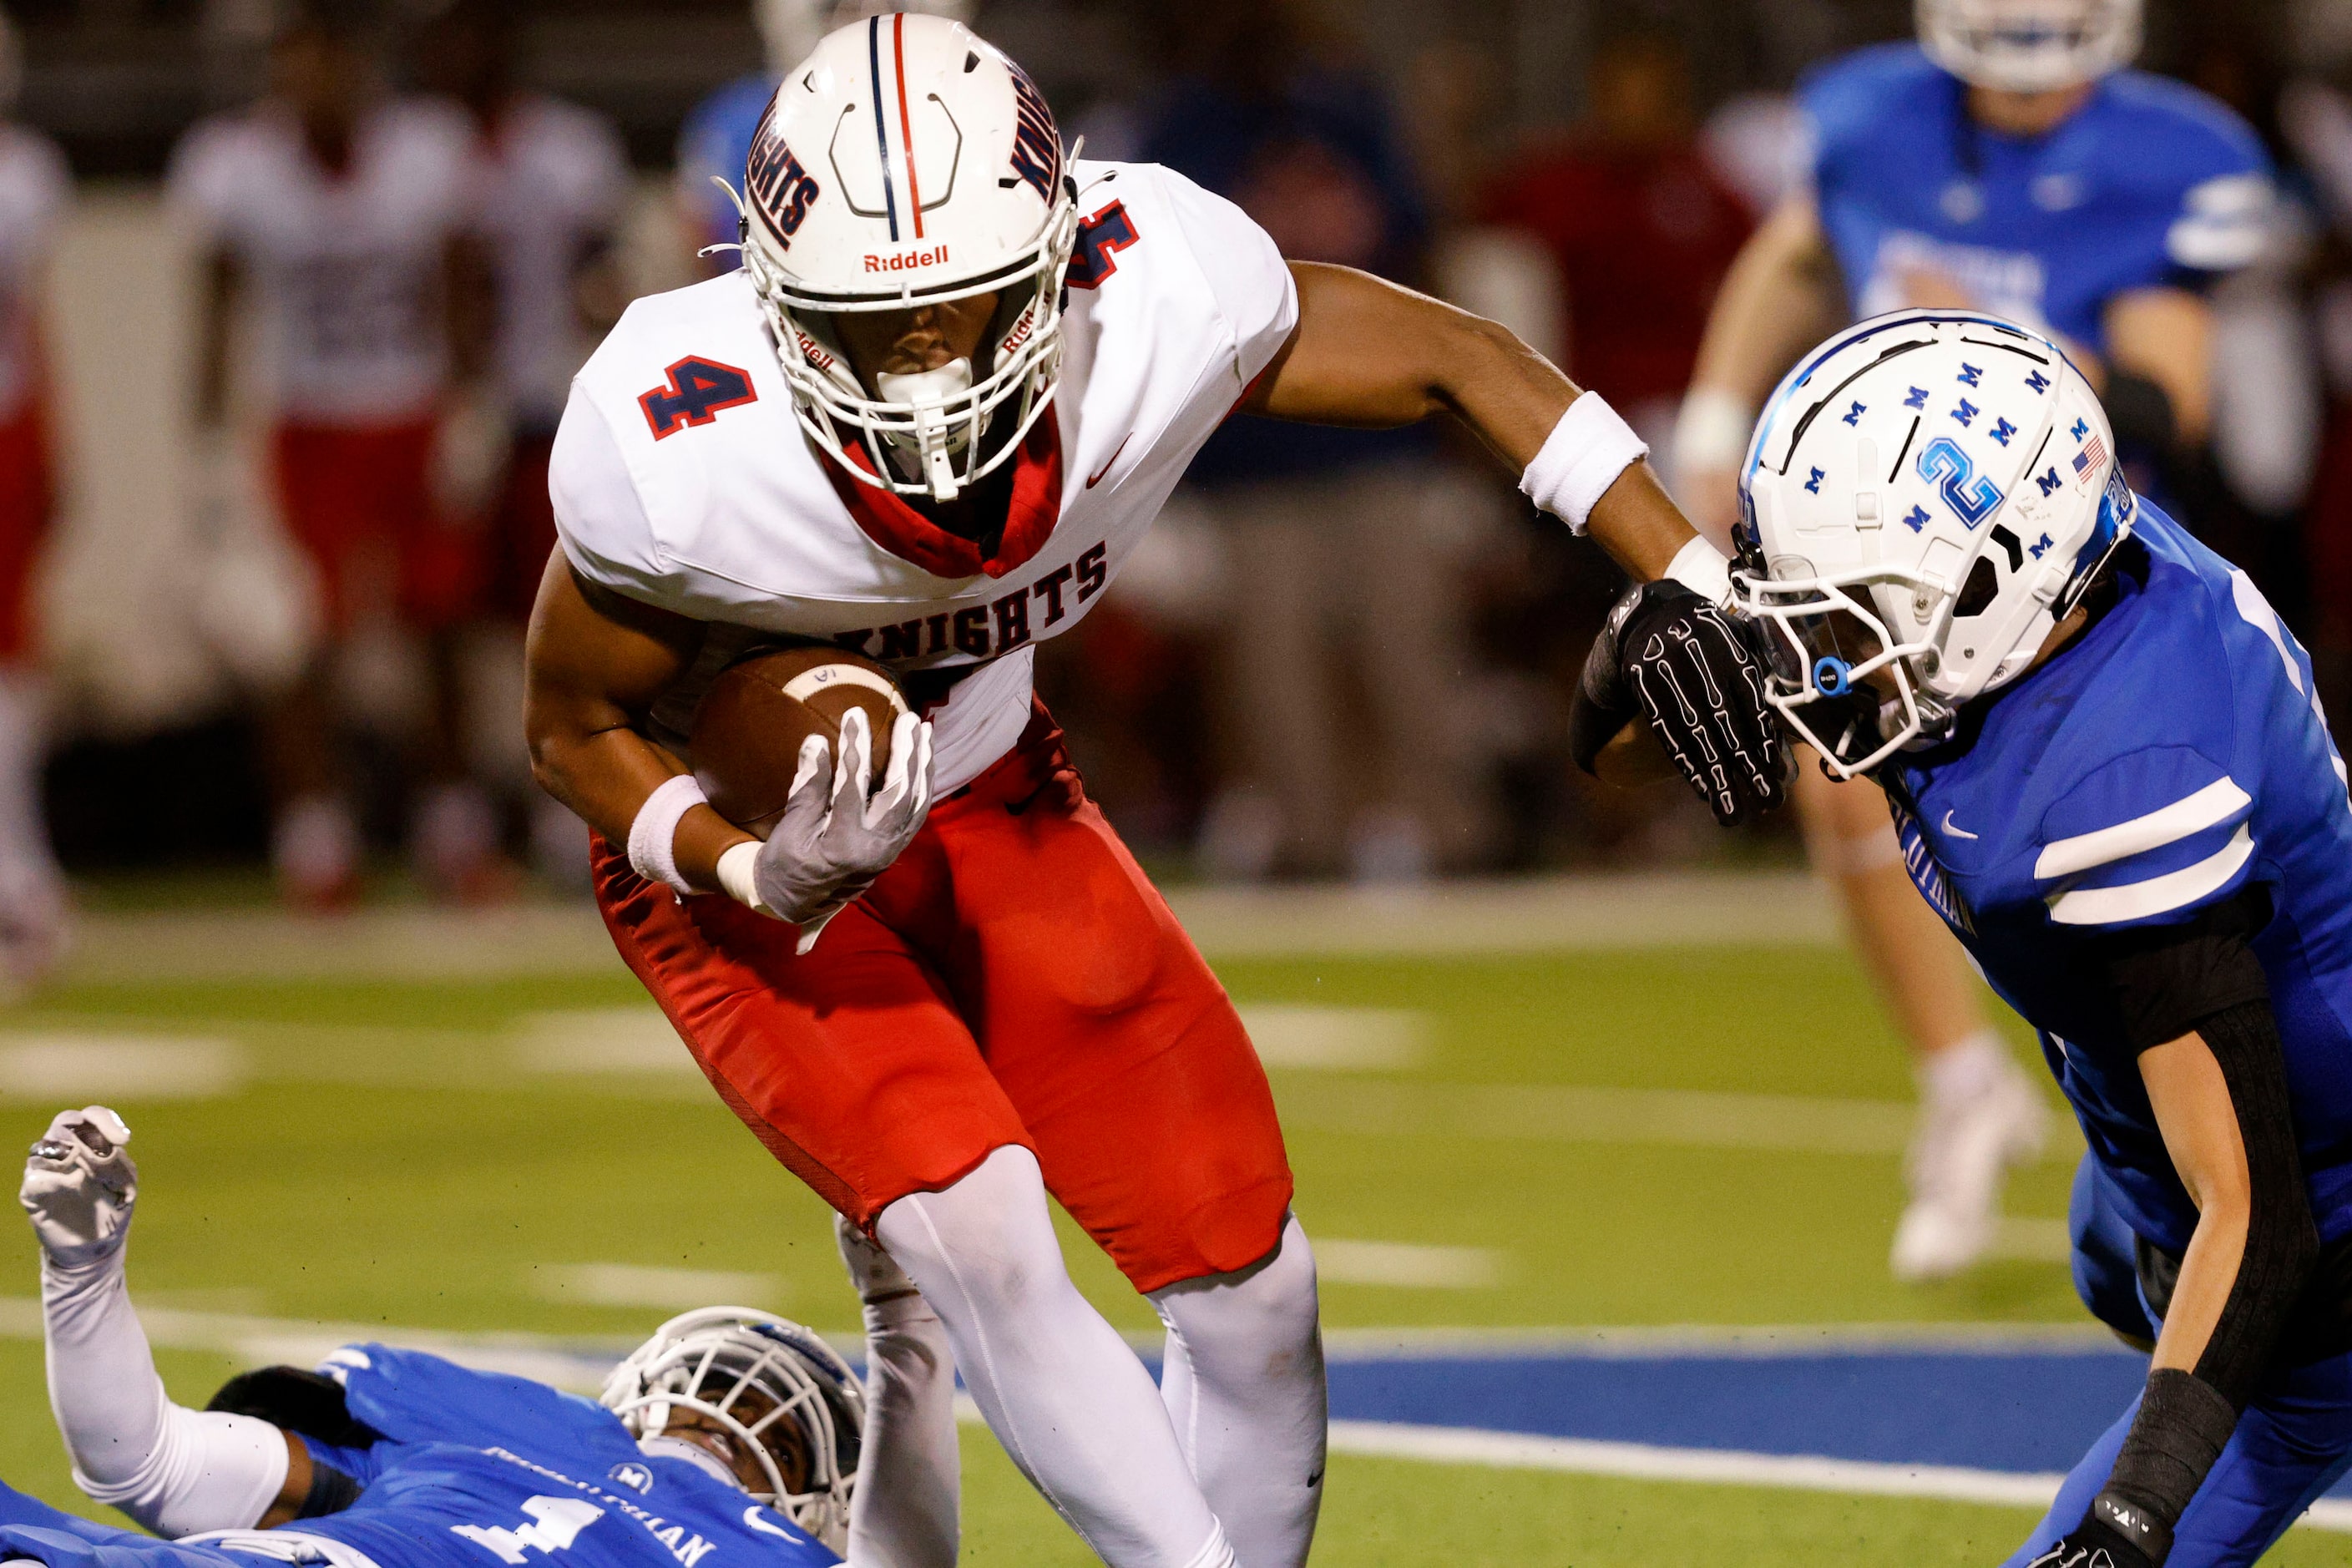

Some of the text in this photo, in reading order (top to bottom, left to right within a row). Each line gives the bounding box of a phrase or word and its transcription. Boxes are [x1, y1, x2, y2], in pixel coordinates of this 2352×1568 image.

[863, 245, 948, 272] Riddell
[1956, 362, 1984, 388] M
[2024, 369, 2051, 396] M
[636, 354, 759, 443] 4
[1903, 385, 1930, 411] M
[1950, 397, 1980, 428] M
[1842, 400, 1867, 427] M
[1988, 416, 2018, 448] M
[2069, 417, 2090, 444] M
[1803, 465, 1826, 495] M
[1915, 437, 2005, 532] 2
[2035, 466, 2063, 498] M
[1902, 503, 1932, 534] M
[2028, 532, 2055, 561] M
